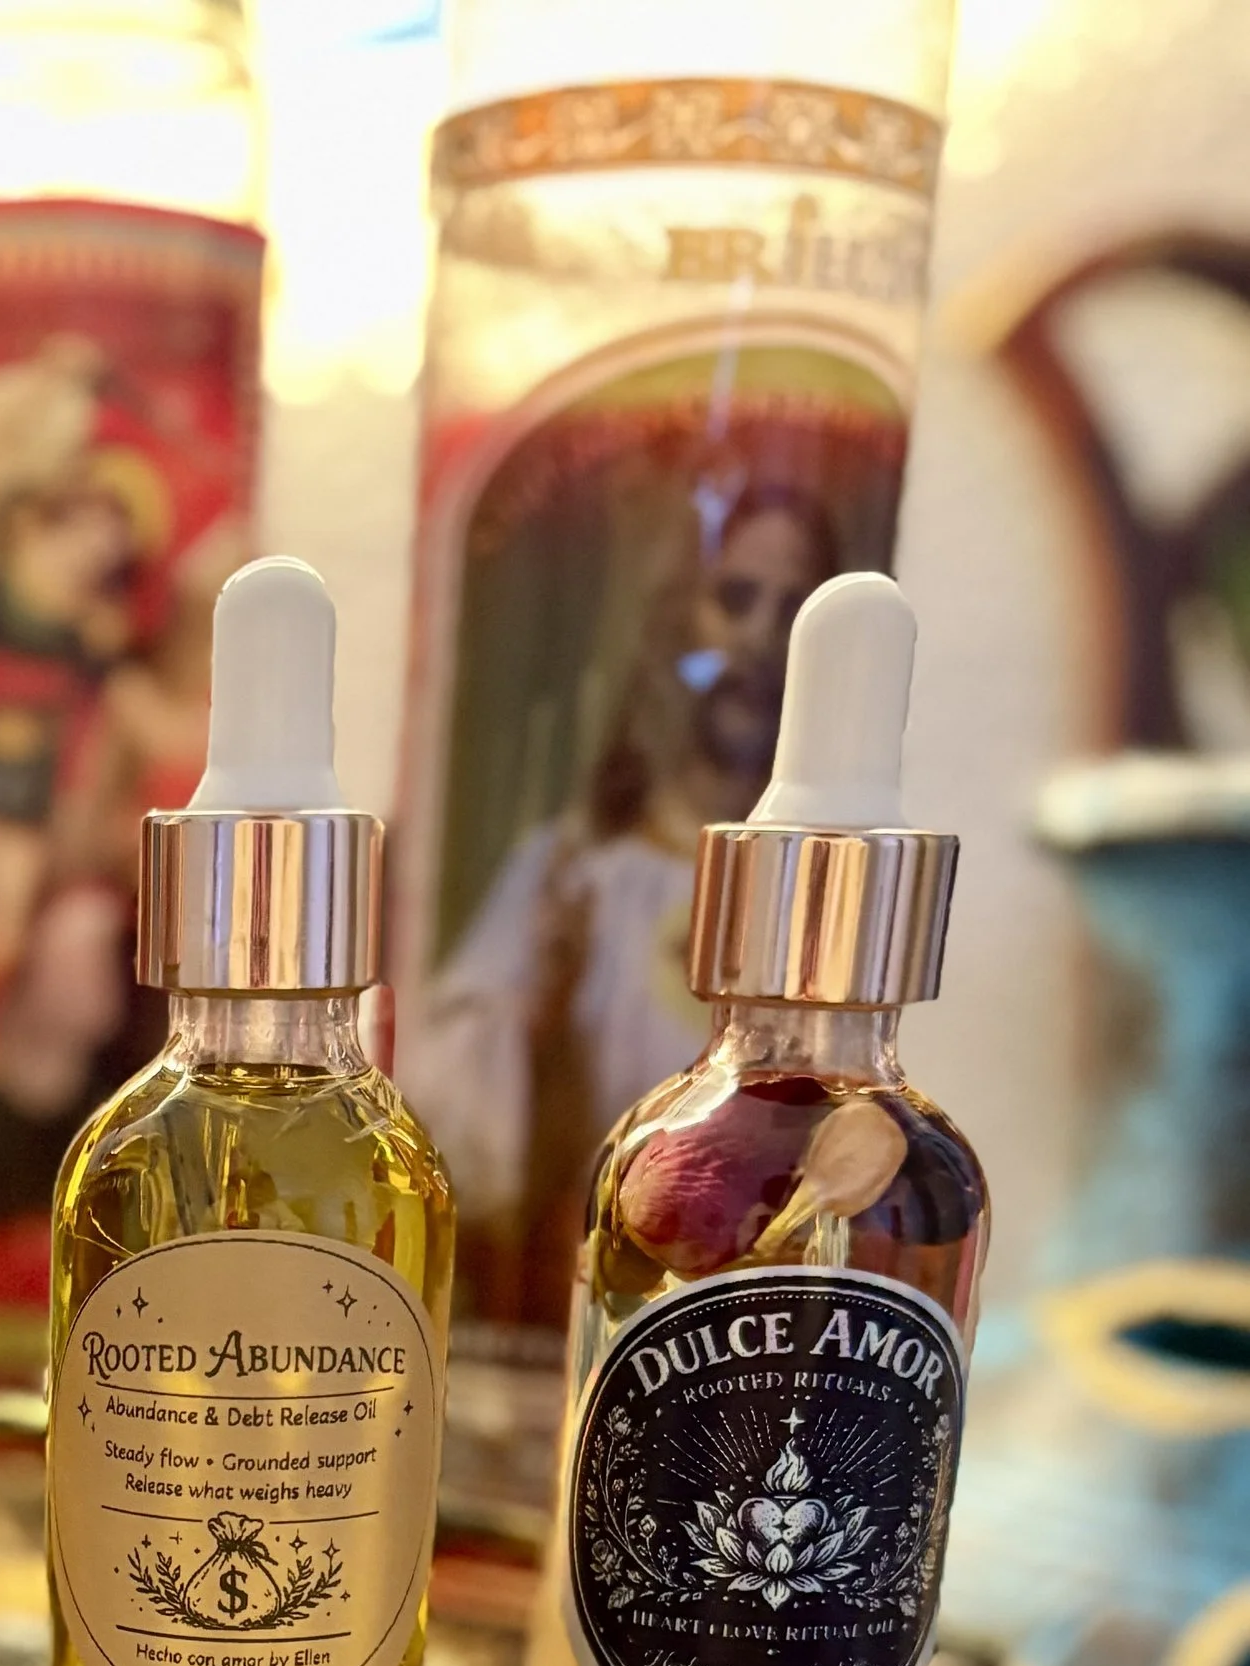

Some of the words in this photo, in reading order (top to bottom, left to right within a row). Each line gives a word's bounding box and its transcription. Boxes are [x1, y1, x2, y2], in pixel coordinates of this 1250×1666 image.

[82, 1331, 197, 1381] ROOTED
[204, 1330, 406, 1378] ABUNDANCE
[628, 1312, 795, 1398] DULCE
[809, 1308, 944, 1401] AMOR
[683, 1371, 783, 1404] ROOTED
[793, 1372, 892, 1402] RITUALS
[105, 1395, 198, 1425] Abundance
[204, 1407, 219, 1426] &
[228, 1406, 274, 1427] Debt
[280, 1405, 348, 1427] Release
[353, 1398, 377, 1421] Oil
[104, 1440, 154, 1467] Steady
[160, 1448, 199, 1469] flow
[222, 1451, 310, 1472] Grounded
[317, 1448, 377, 1474] support
[125, 1473, 183, 1496] Release
[188, 1482, 234, 1501] what
[240, 1482, 300, 1504] weighs
[306, 1480, 352, 1499] heavy
[136, 1643, 183, 1664] Hecho
[294, 1648, 331, 1666] Ellen
